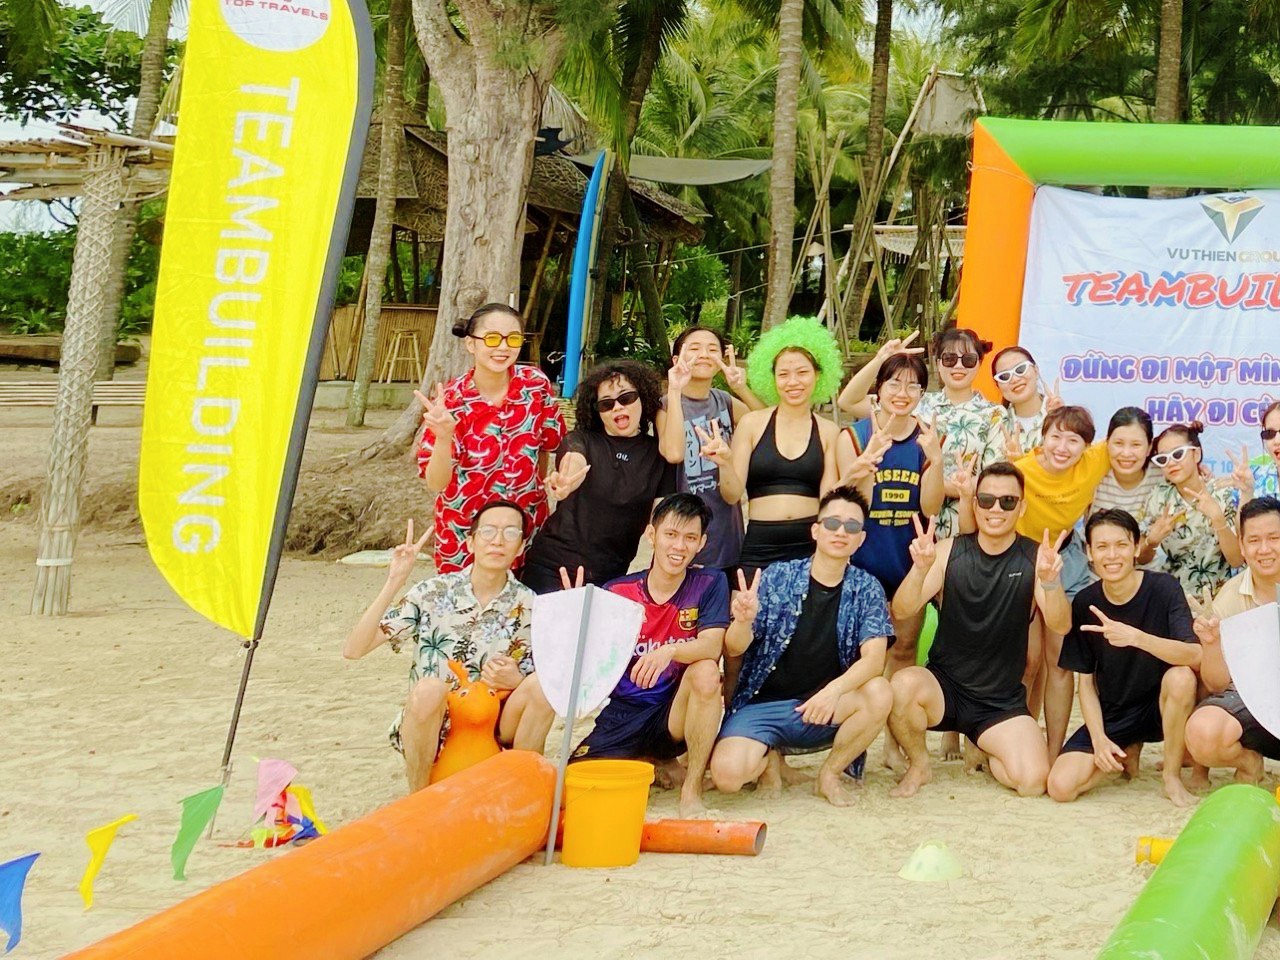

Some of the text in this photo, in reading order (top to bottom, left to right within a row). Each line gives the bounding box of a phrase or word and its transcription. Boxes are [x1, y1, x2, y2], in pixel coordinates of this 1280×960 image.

[258, 1, 328, 21] TRAVELS
[171, 76, 300, 555] TEAMBUILDING
[1140, 357, 1169, 381] ĐI
[1148, 394, 1204, 424] HÃY
[1206, 399, 1238, 424] ĐI
